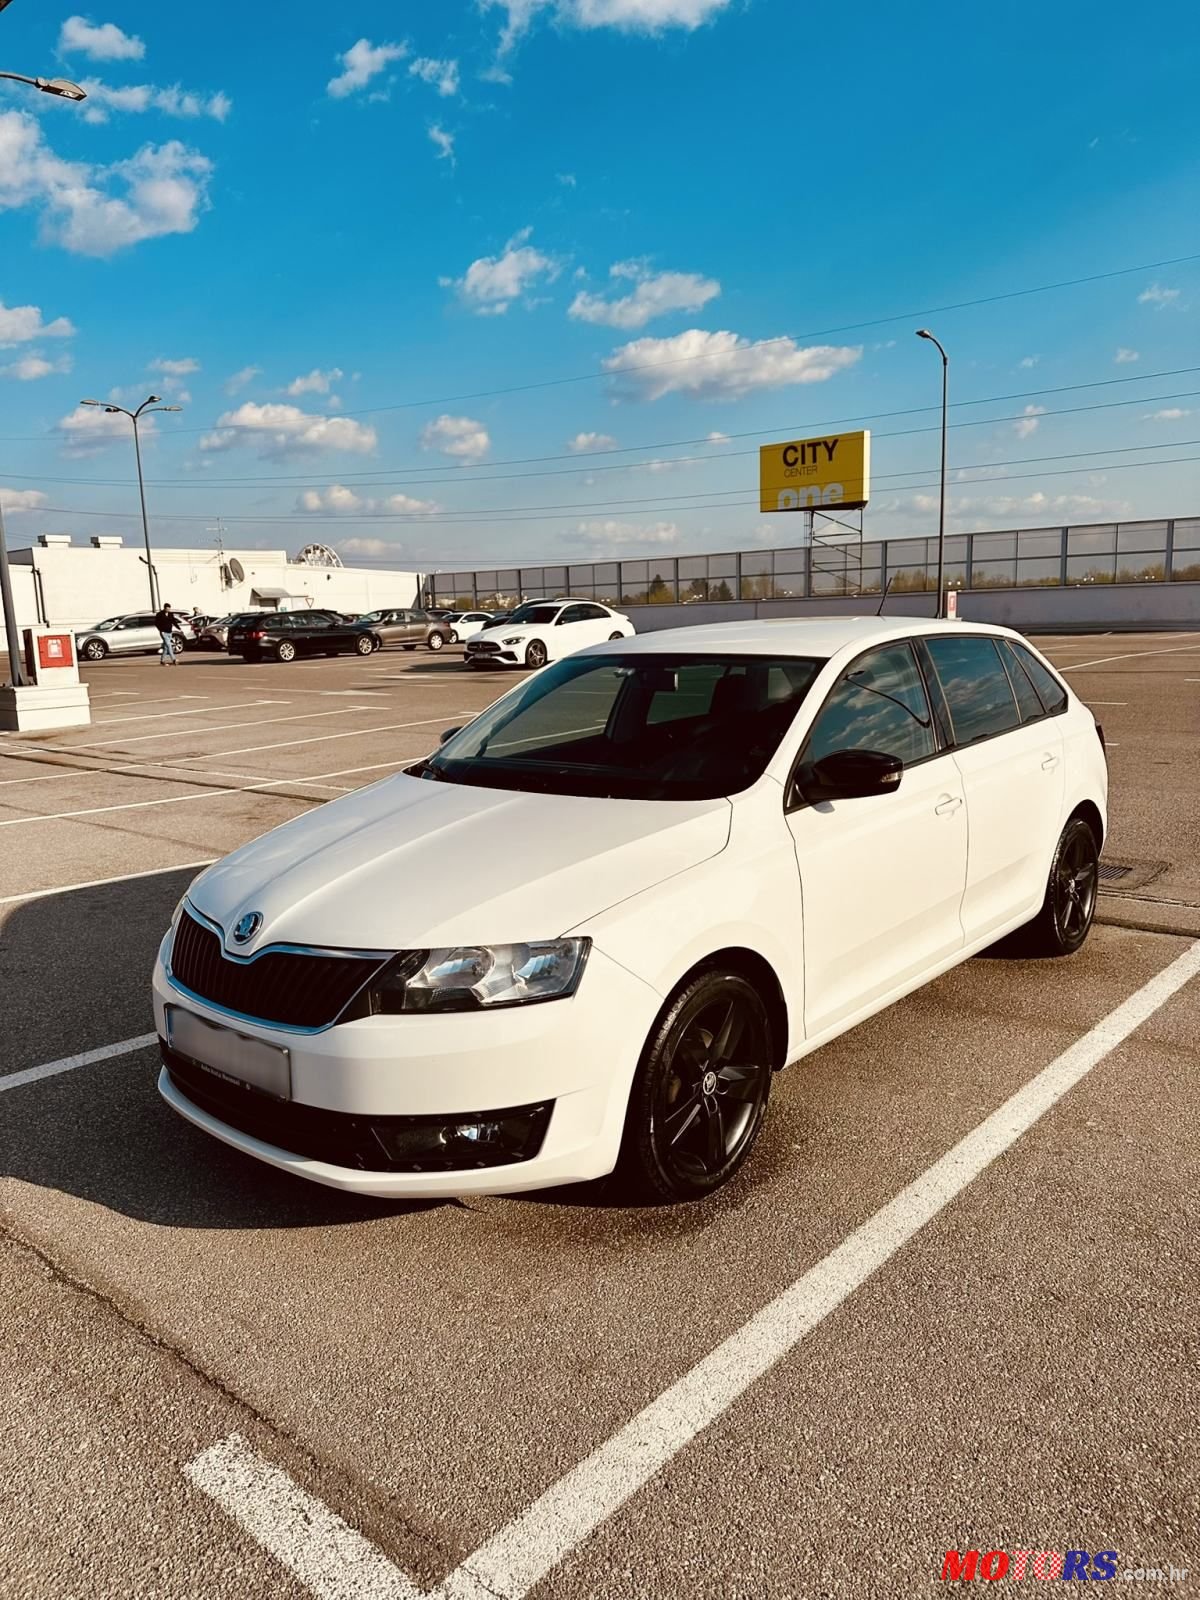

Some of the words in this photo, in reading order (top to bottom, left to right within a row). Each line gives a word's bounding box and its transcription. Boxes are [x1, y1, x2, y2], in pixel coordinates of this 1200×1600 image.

[783, 439, 839, 467] CITY
[784, 466, 818, 478] CENTER
[777, 483, 844, 510] one
